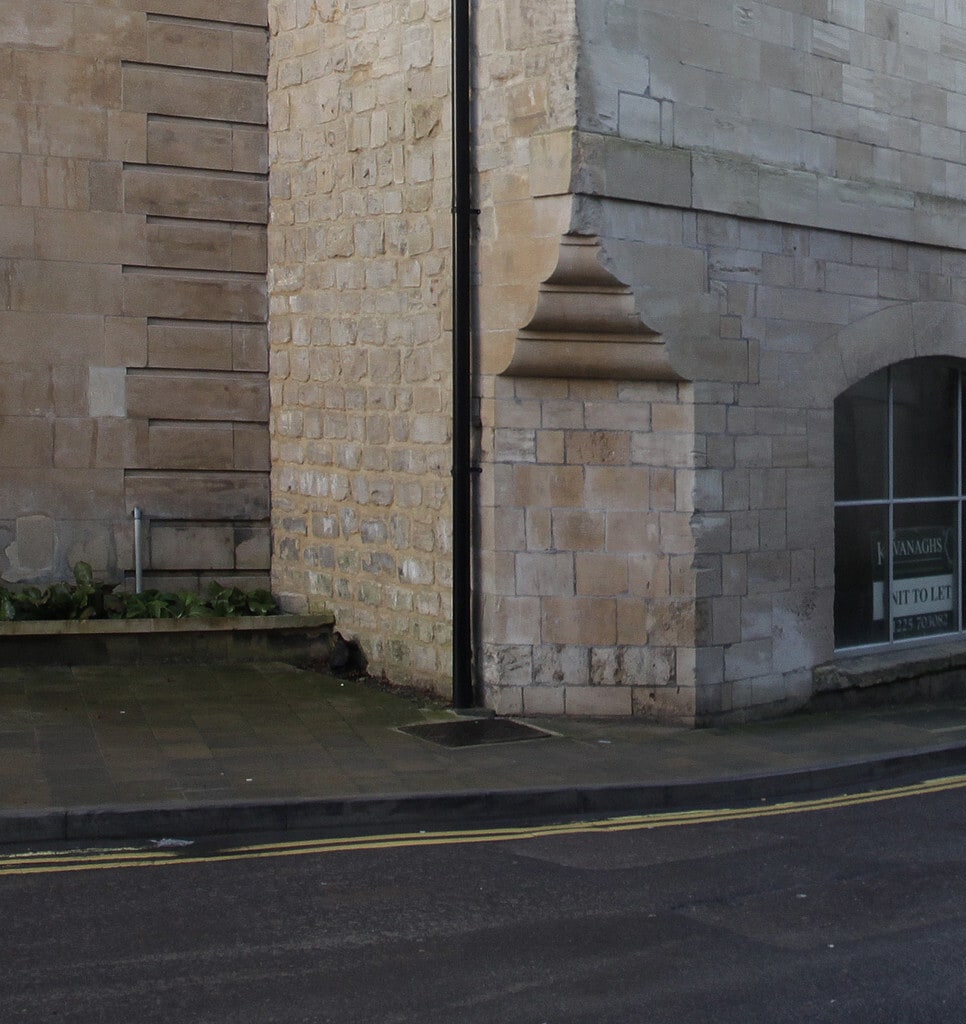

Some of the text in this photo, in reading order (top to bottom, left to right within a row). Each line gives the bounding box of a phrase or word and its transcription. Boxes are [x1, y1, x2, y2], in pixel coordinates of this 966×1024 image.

[877, 538, 943, 565] KVANAGHS
[892, 585, 952, 606] NIT TO LET
